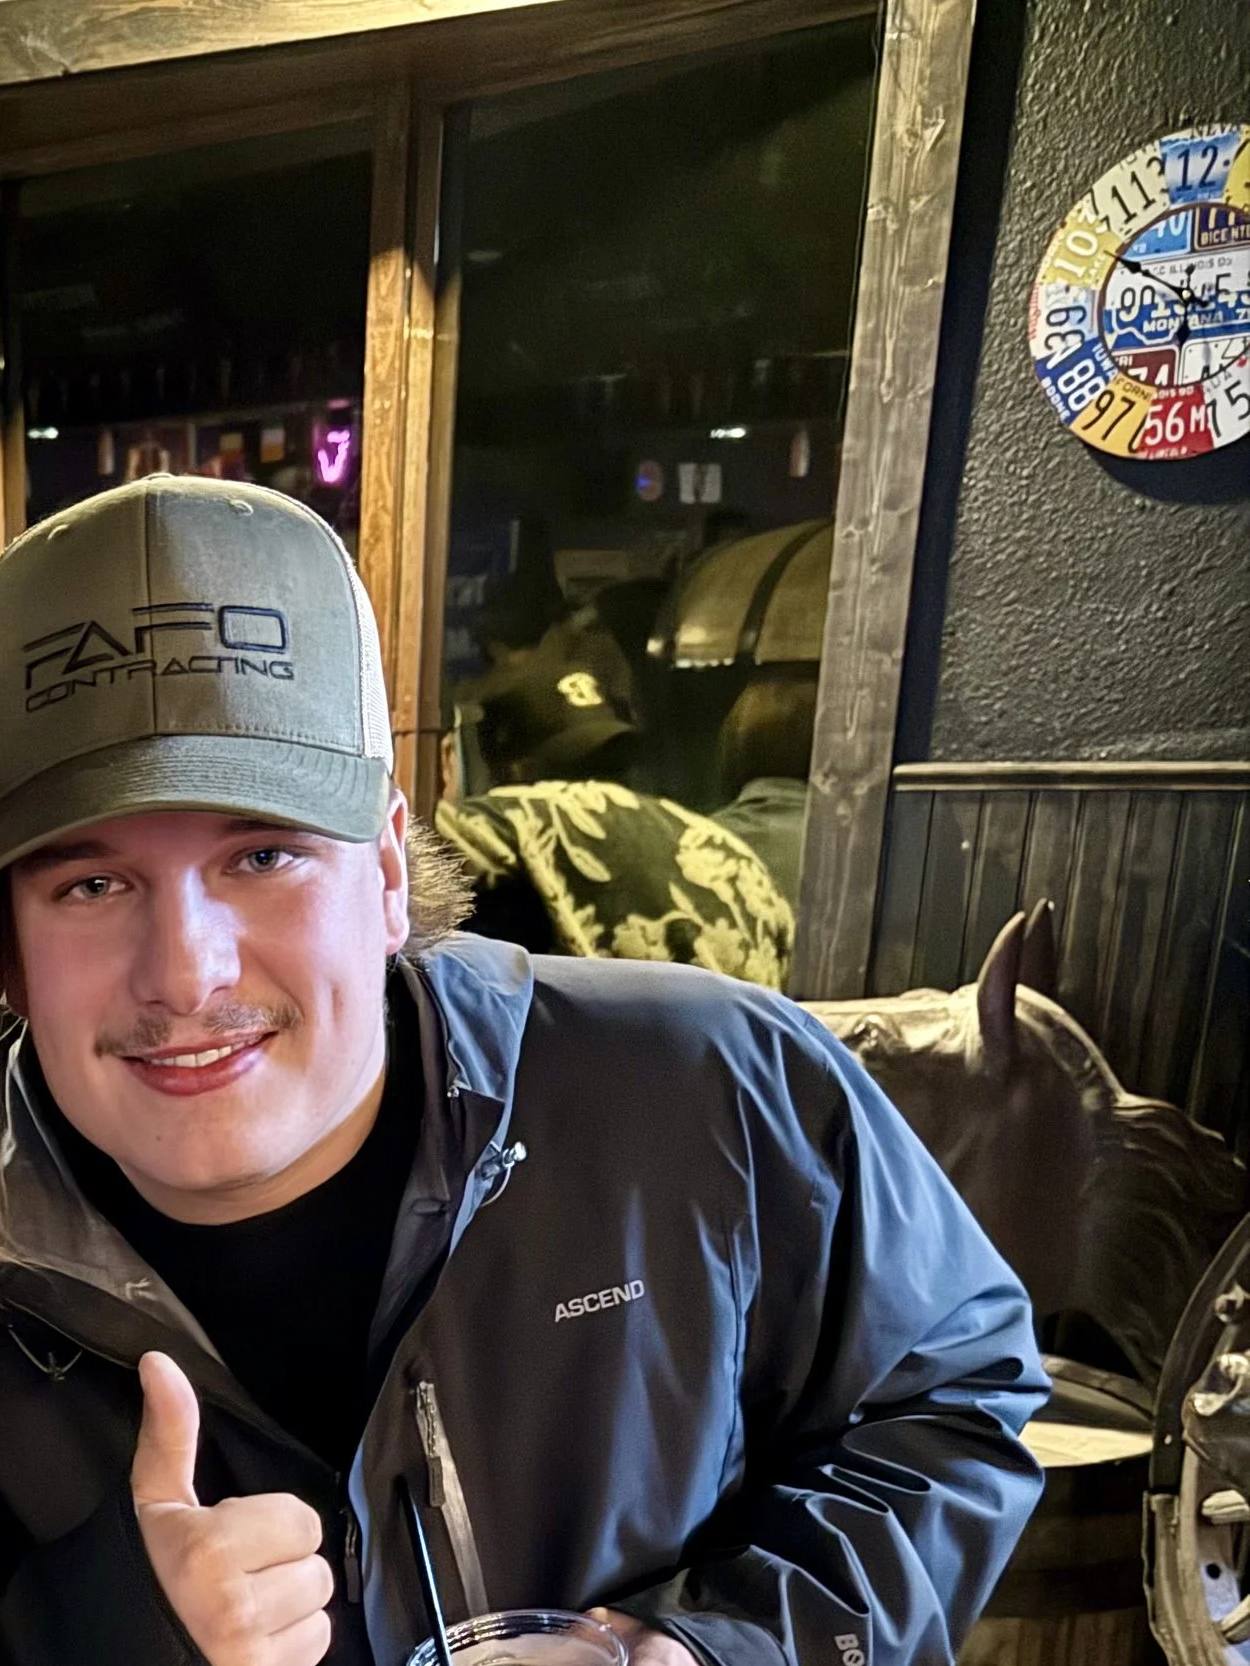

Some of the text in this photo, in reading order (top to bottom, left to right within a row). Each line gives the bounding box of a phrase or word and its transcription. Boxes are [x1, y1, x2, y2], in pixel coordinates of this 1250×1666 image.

[23, 602, 289, 692] FAFO
[25, 655, 296, 714] CONTRACTING
[554, 1279, 646, 1323] ASCEND
